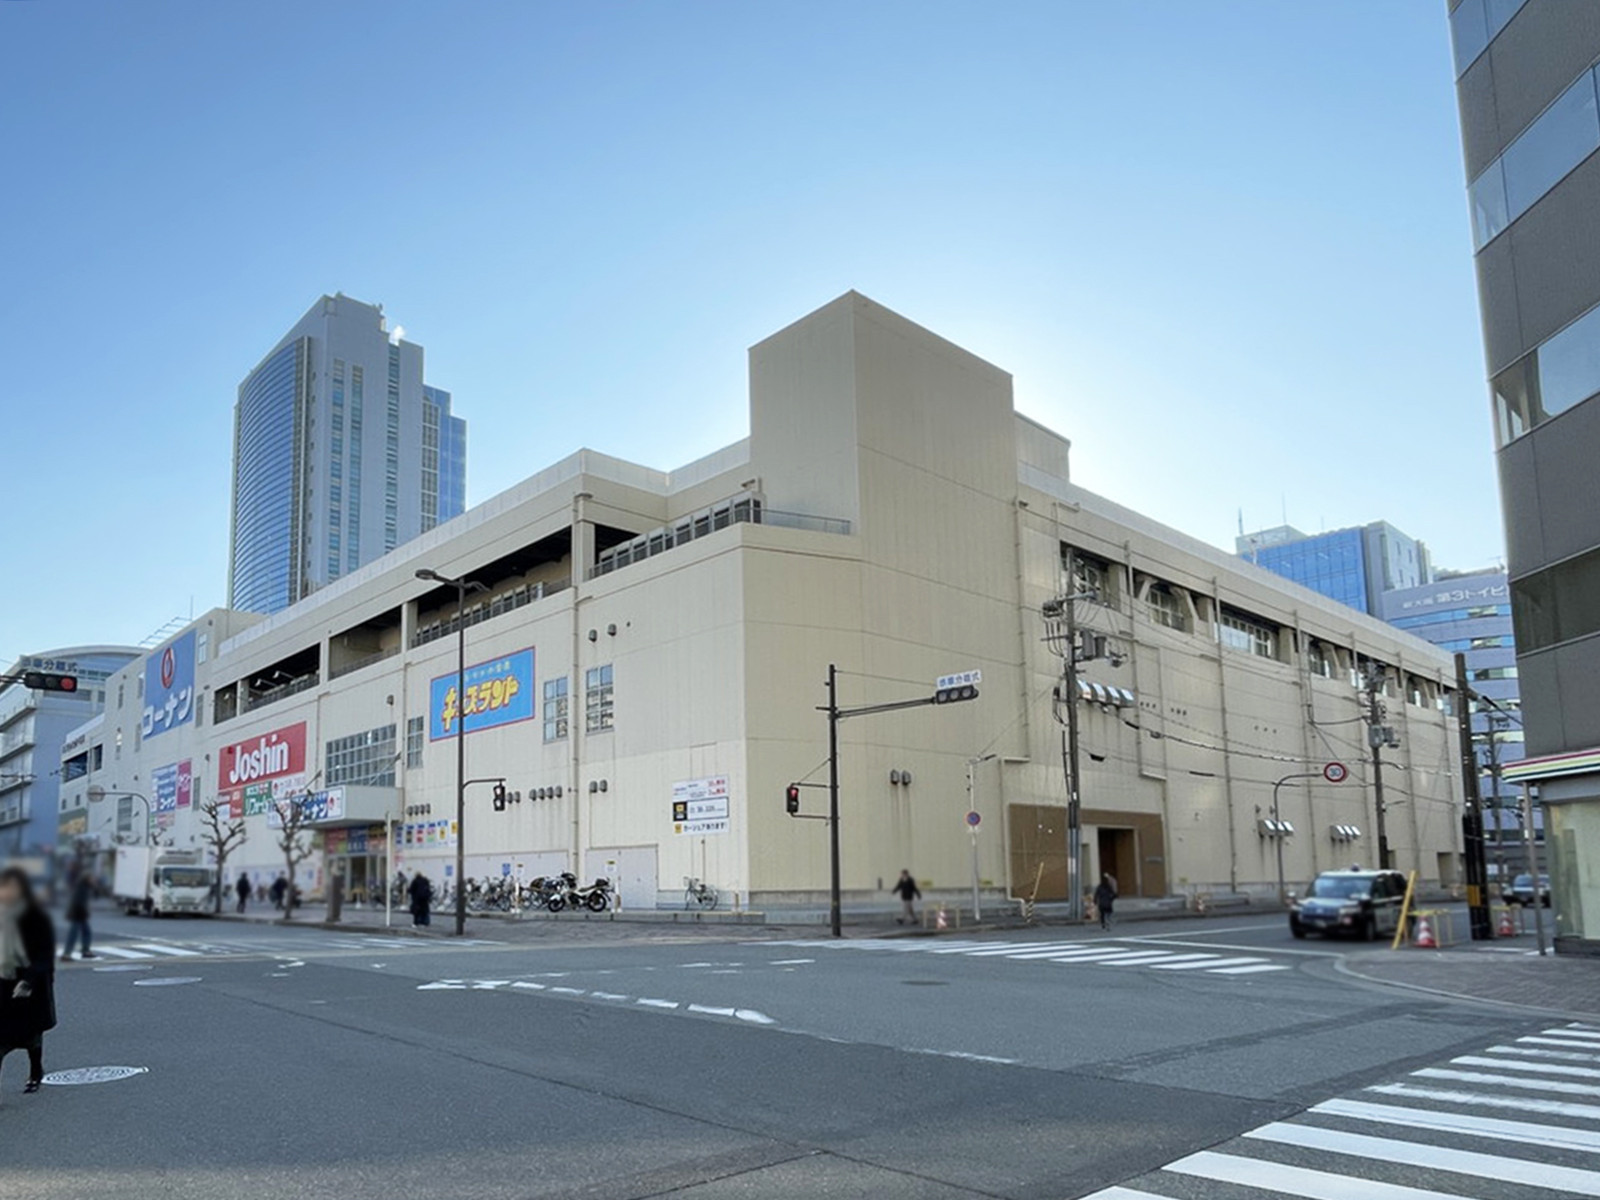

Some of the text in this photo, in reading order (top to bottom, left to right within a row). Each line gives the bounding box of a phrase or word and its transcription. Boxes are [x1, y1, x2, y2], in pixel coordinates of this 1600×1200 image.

[143, 685, 192, 736] コーナン
[229, 734, 288, 784] Joshin
